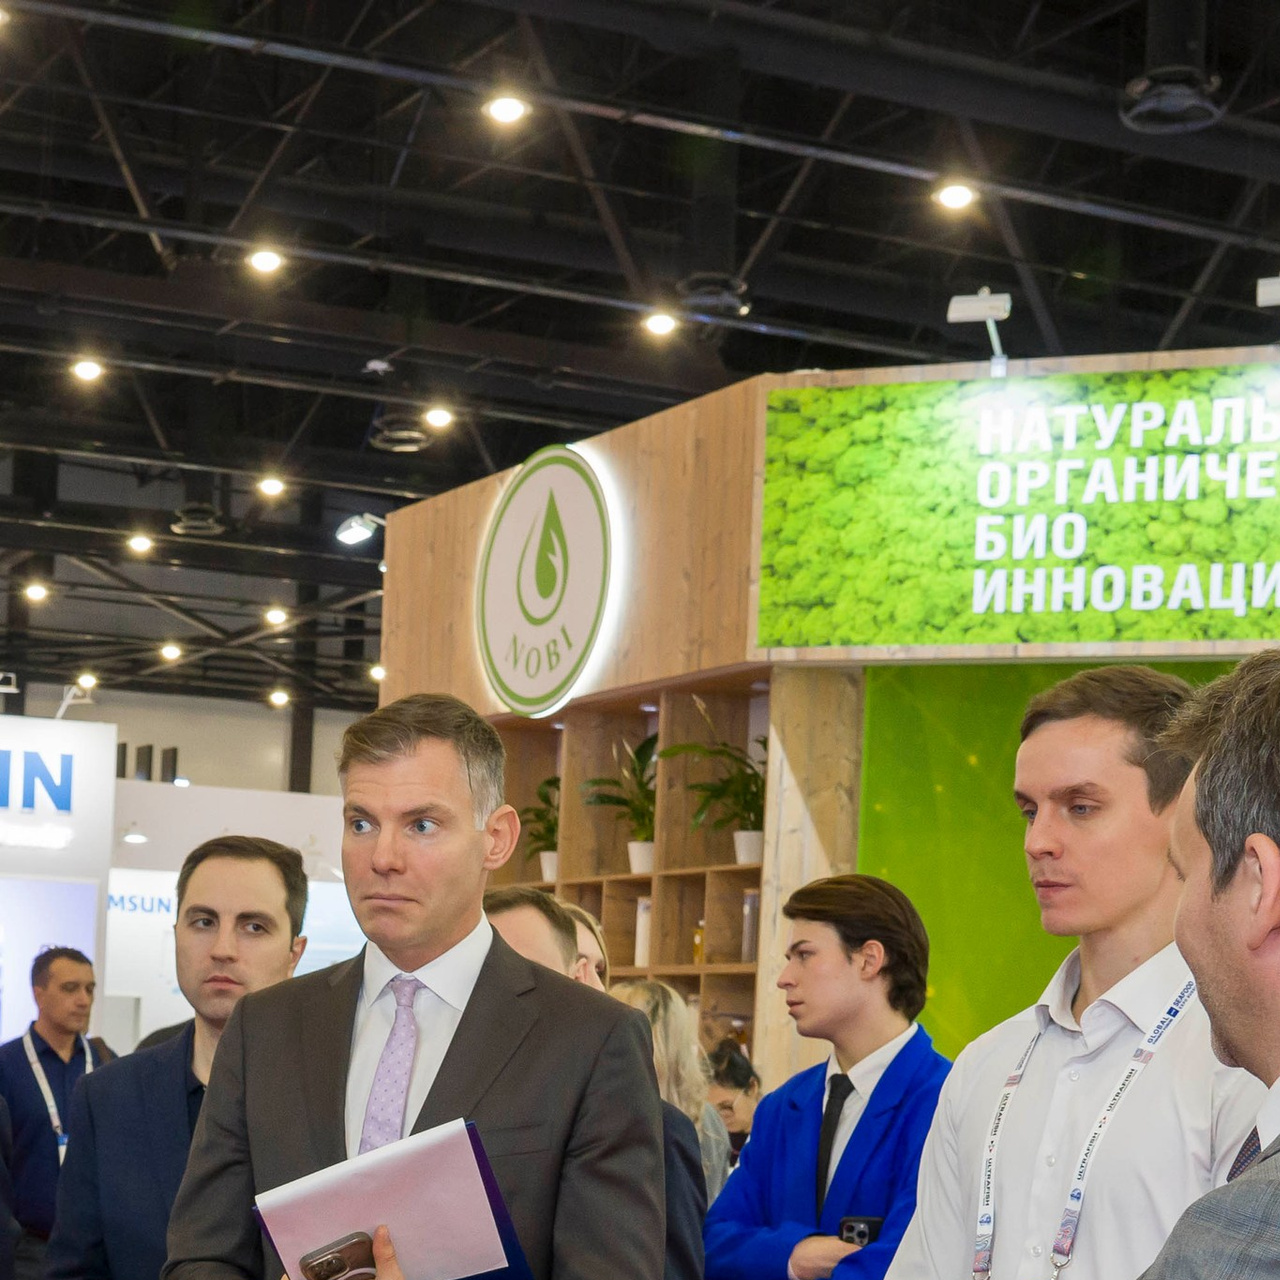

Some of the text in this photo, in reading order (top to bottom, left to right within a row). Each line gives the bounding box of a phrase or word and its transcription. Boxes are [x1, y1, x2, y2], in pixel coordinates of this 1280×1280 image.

[976, 452, 1278, 507] ОРГАНИЧЕ
[974, 512, 1087, 561] БИО
[505, 624, 572, 679] NOBI
[107, 895, 171, 913] MSUN
[1147, 1017, 1170, 1044] GLOBAL
[1173, 981, 1194, 1007] SEAFOOD
[984, 1092, 1011, 1207] ULTRAFISH ULTRAFISH
[1077, 1068, 1135, 1181] ULTRAFISH ULTRAFISH
